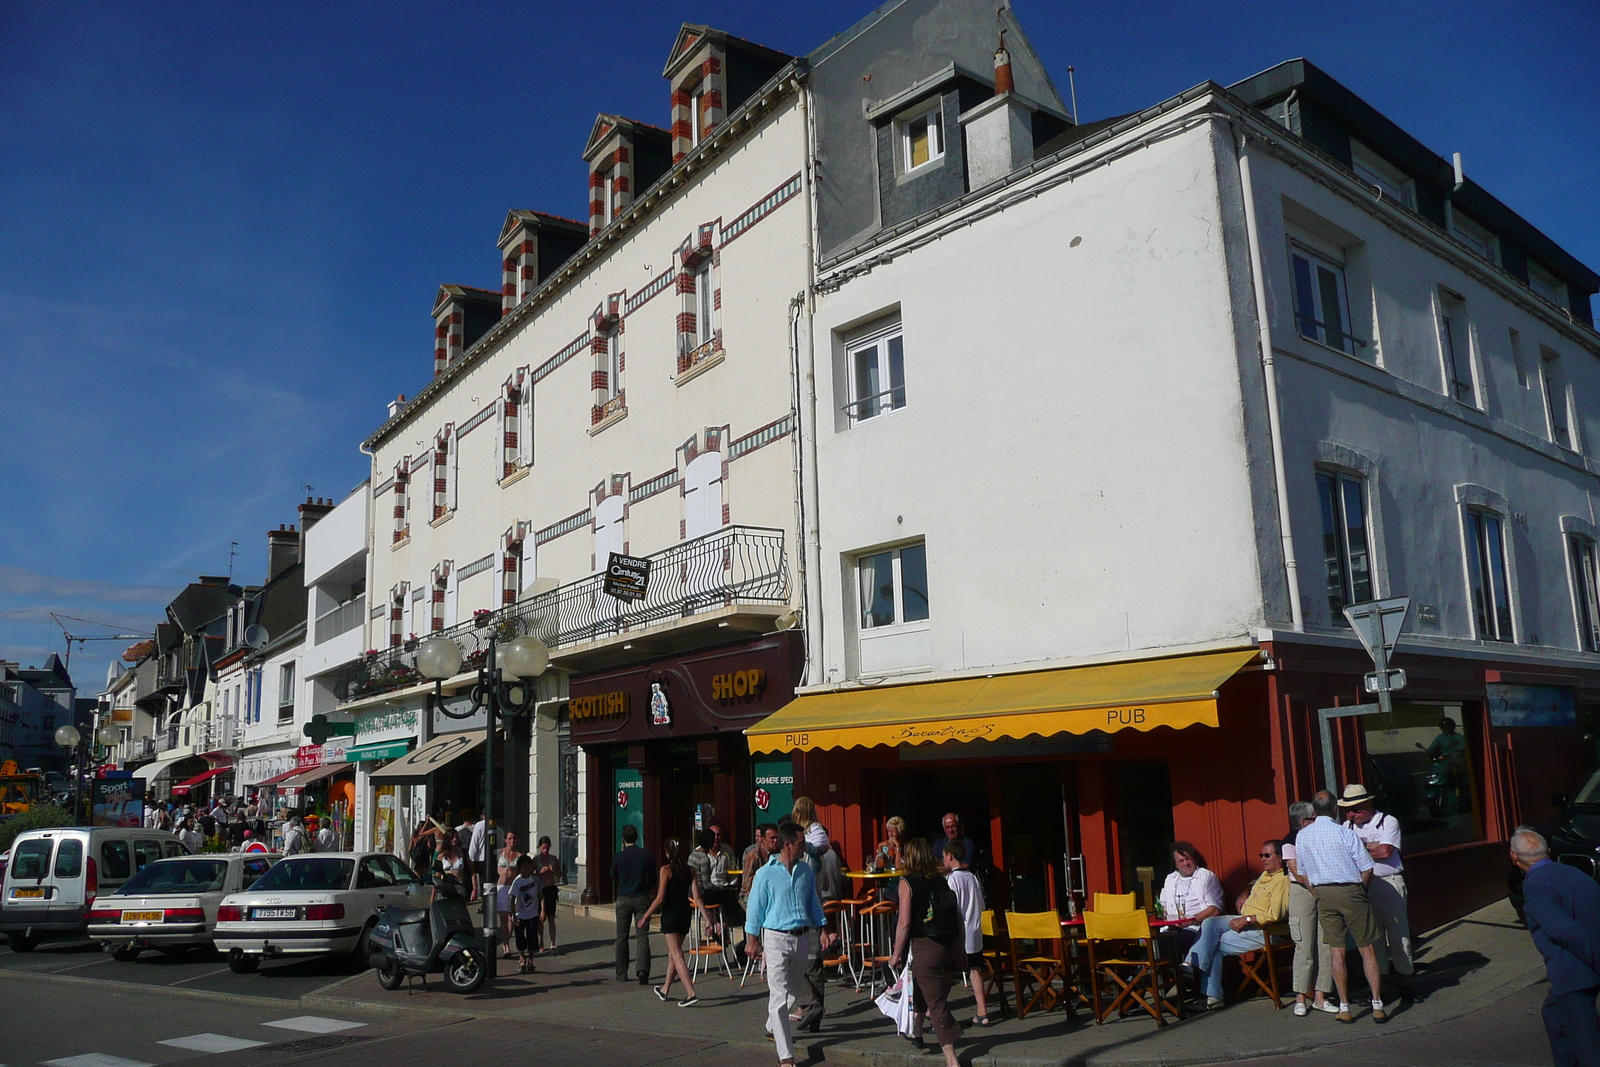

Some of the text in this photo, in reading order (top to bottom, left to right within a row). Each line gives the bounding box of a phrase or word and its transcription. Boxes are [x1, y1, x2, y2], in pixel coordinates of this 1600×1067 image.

[612, 555, 647, 569] A VENDRE
[611, 565, 646, 586] Century 21
[712, 669, 760, 700] SHOP
[569, 691, 624, 719] SCOTTISH
[1107, 708, 1146, 725] PUB
[786, 733, 809, 747] PUB
